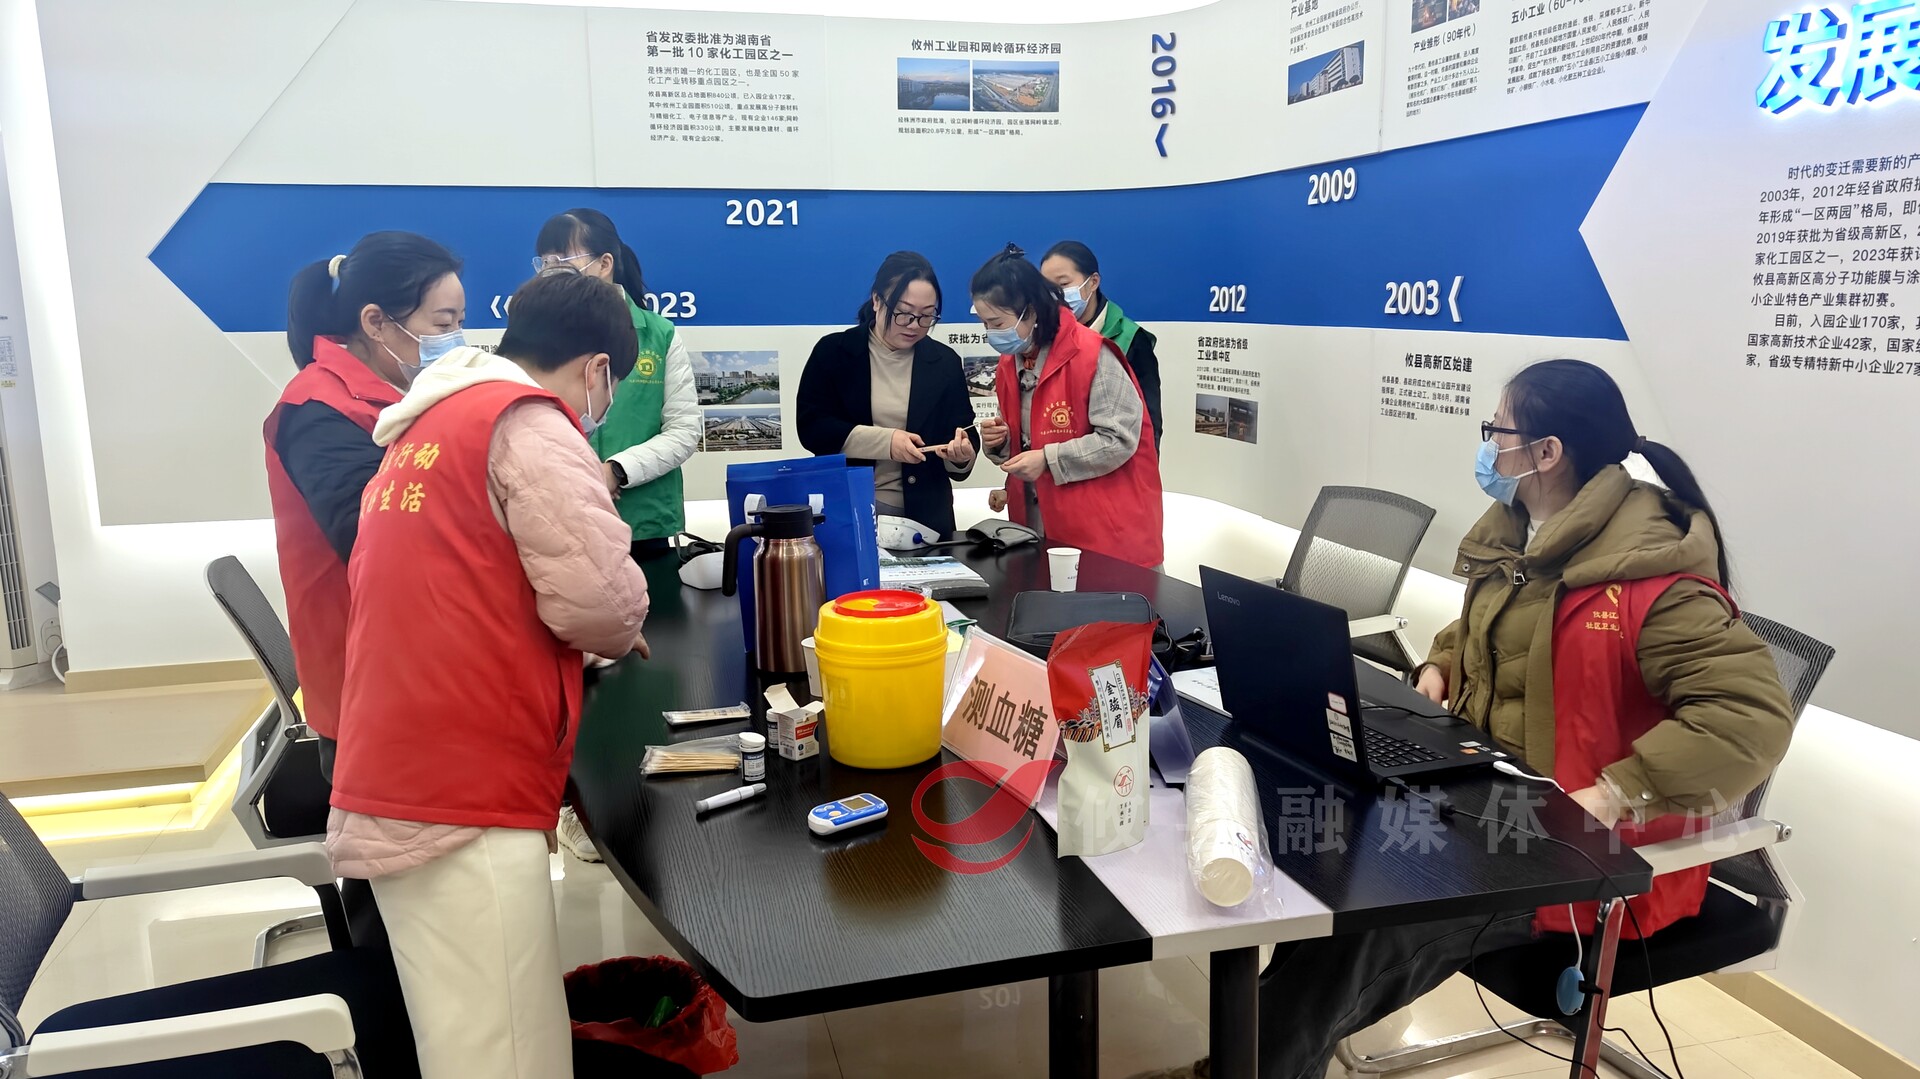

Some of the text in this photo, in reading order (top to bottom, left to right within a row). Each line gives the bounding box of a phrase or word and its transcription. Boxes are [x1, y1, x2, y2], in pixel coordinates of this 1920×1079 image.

[1291, 0, 1319, 19] 产业基地
[646, 31, 771, 46] 省发改委批准为湖南省
[911, 39, 1062, 54] 攸州工业园和网岭循环经济园
[647, 45, 793, 60] 第一批 10 家化工园区之一
[1756, 2, 1920, 114] 发展
[648, 77, 750, 87] 化工产业转移重点园区之一。
[792, 70, 799, 78] 家
[1151, 32, 1177, 119] 2016
[1788, 153, 1920, 180] 时代的变迁需要新的产
[1308, 167, 1357, 206] 2009
[726, 199, 799, 226] 2021
[1753, 269, 1920, 286] 攸县高新区高分子功能膜与涂
[642, 291, 697, 318] 023
[1209, 284, 1247, 313] 2012
[1384, 279, 1441, 316] 2003
[1751, 292, 1897, 308] 小企业特色产业集群初赛。
[1198, 336, 1248, 350] 省政府批准为省级
[1197, 350, 1230, 362] 工业集中区
[1405, 353, 1473, 373] 攸县高新区始建
[1217, 591, 1240, 606] Lenovo
[1115, 673, 1127, 700] CHINESE
[1105, 680, 1123, 729] 金骏眉
[961, 676, 1048, 760] 测血糖
